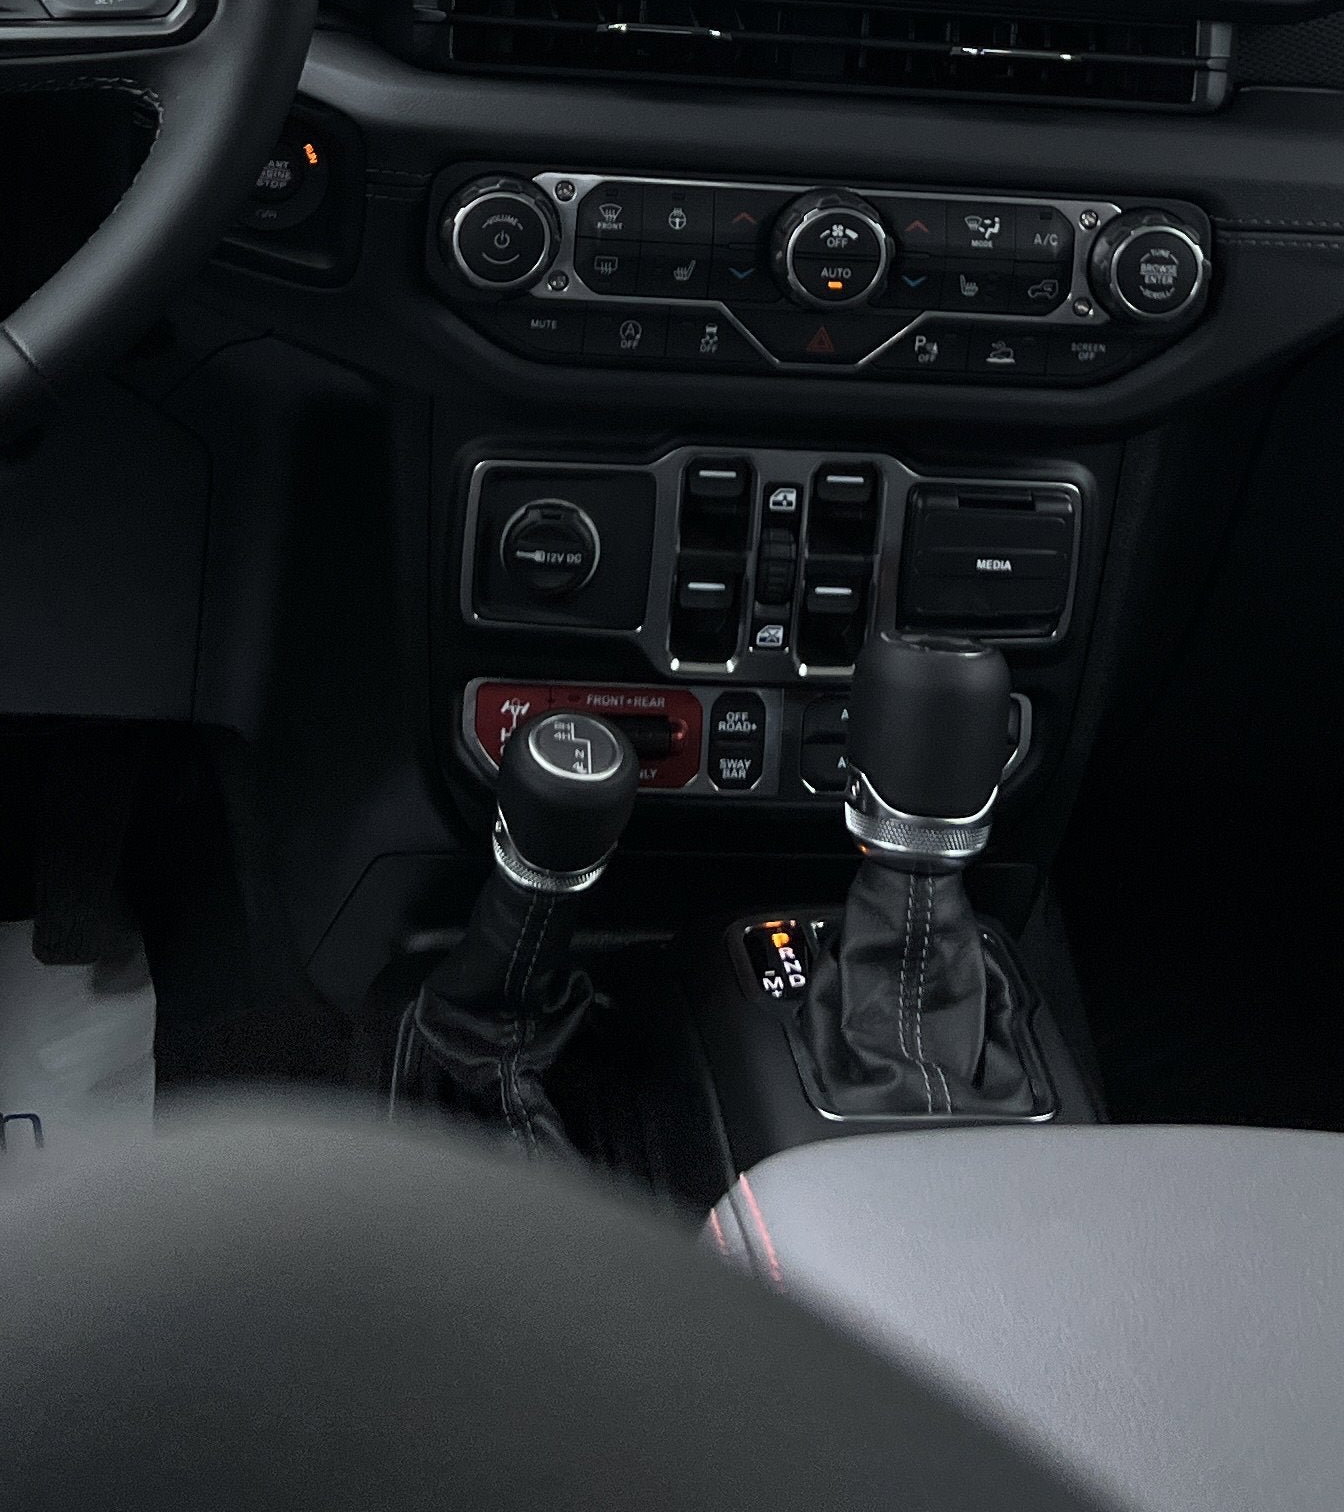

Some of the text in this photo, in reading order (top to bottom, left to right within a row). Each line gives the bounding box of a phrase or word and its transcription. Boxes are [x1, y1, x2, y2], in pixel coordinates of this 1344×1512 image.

[487, 214, 519, 225] VOLUME
[597, 223, 624, 231] FRONT
[826, 238, 849, 249] OFF
[971, 239, 994, 248] MODE
[1033, 233, 1059, 246] A/C
[820, 267, 852, 279] AUTO
[1140, 263, 1178, 276] BROWSE
[1144, 274, 1174, 285] ENTER
[530, 318, 557, 330] MUTE
[620, 339, 639, 350] OFF
[699, 342, 718, 353] OFF
[1071, 342, 1106, 353] SCREEN
[918, 353, 937, 363] OFF
[546, 551, 582, 564] 12V DC
[976, 558, 1013, 572] MEDIA
[726, 711, 749, 722] OFF
[553, 731, 571, 741] 4H
[719, 758, 752, 770] SWAY
[722, 768, 747, 780] BAR
[771, 932, 791, 948] P
[778, 947, 796, 961] R
[783, 959, 802, 974] N
[762, 976, 784, 991] M
[788, 974, 806, 988] D
